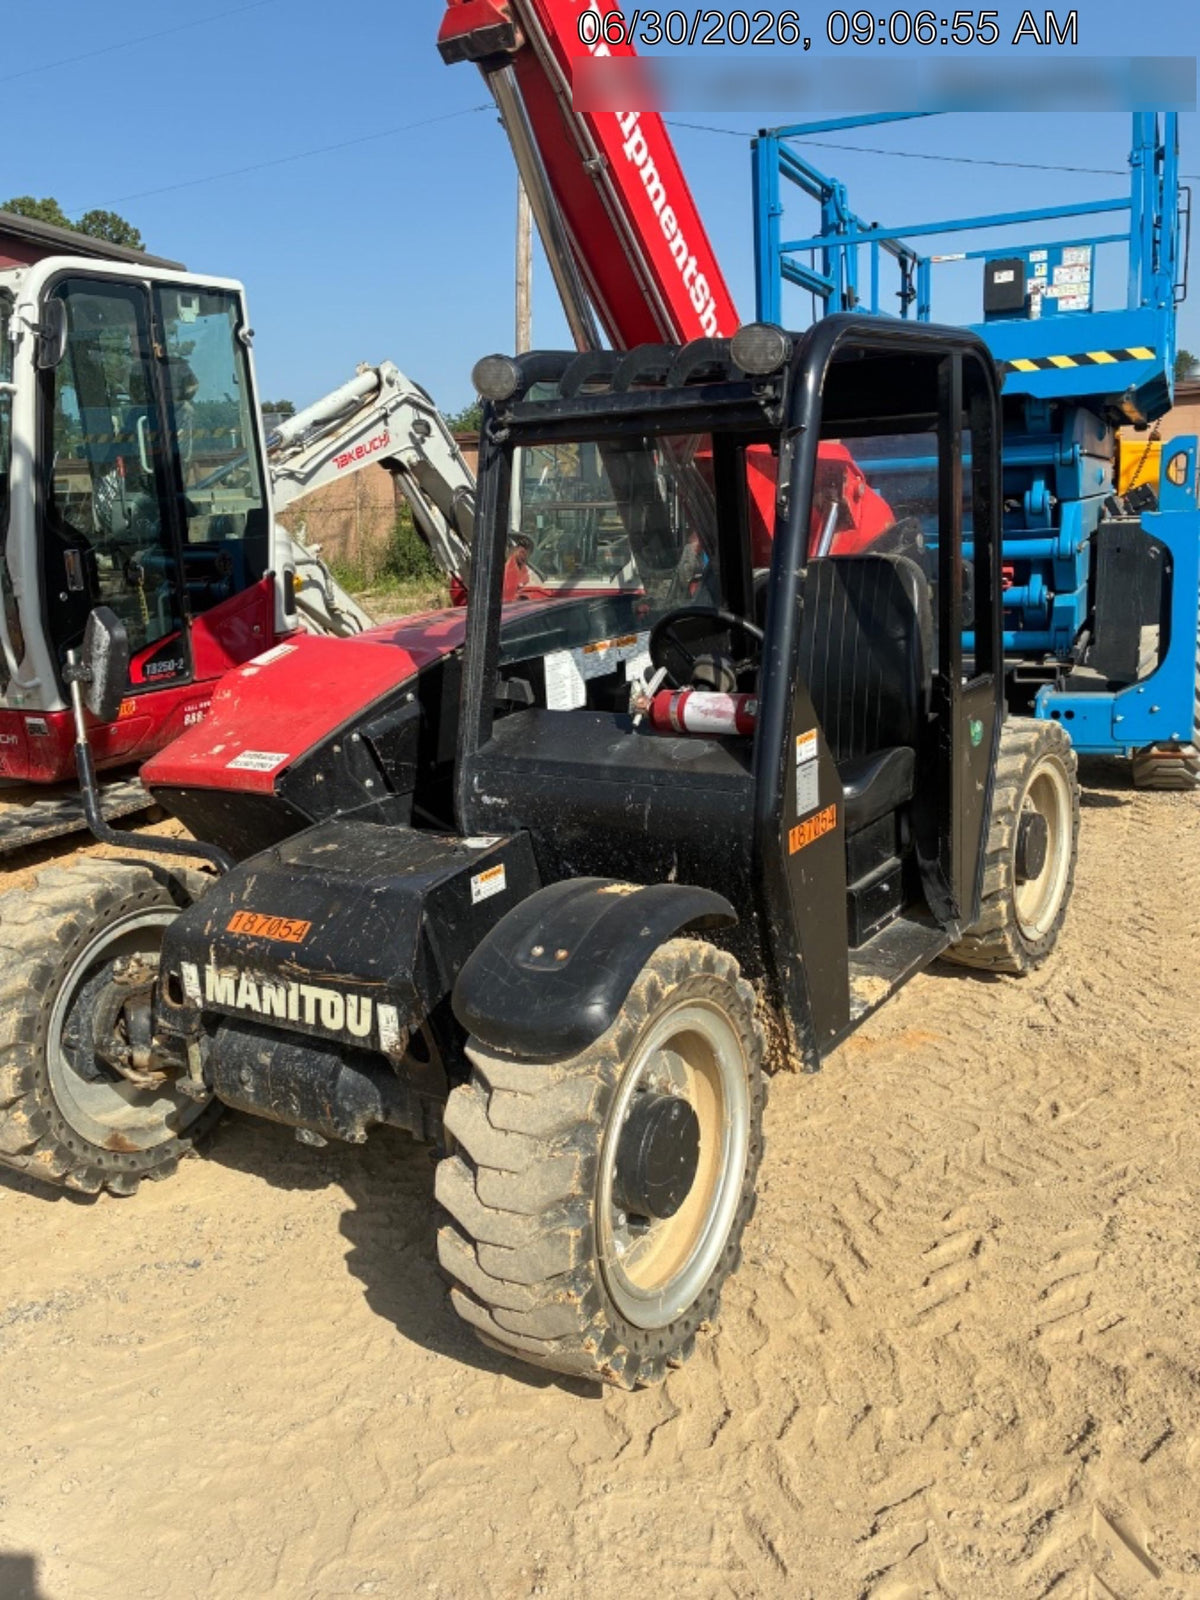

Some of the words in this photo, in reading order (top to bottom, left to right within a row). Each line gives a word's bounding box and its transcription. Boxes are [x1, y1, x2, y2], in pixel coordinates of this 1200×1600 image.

[790, 805, 836, 850] 187054
[231, 912, 309, 941] 187054
[204, 963, 373, 1038] MANITOU
